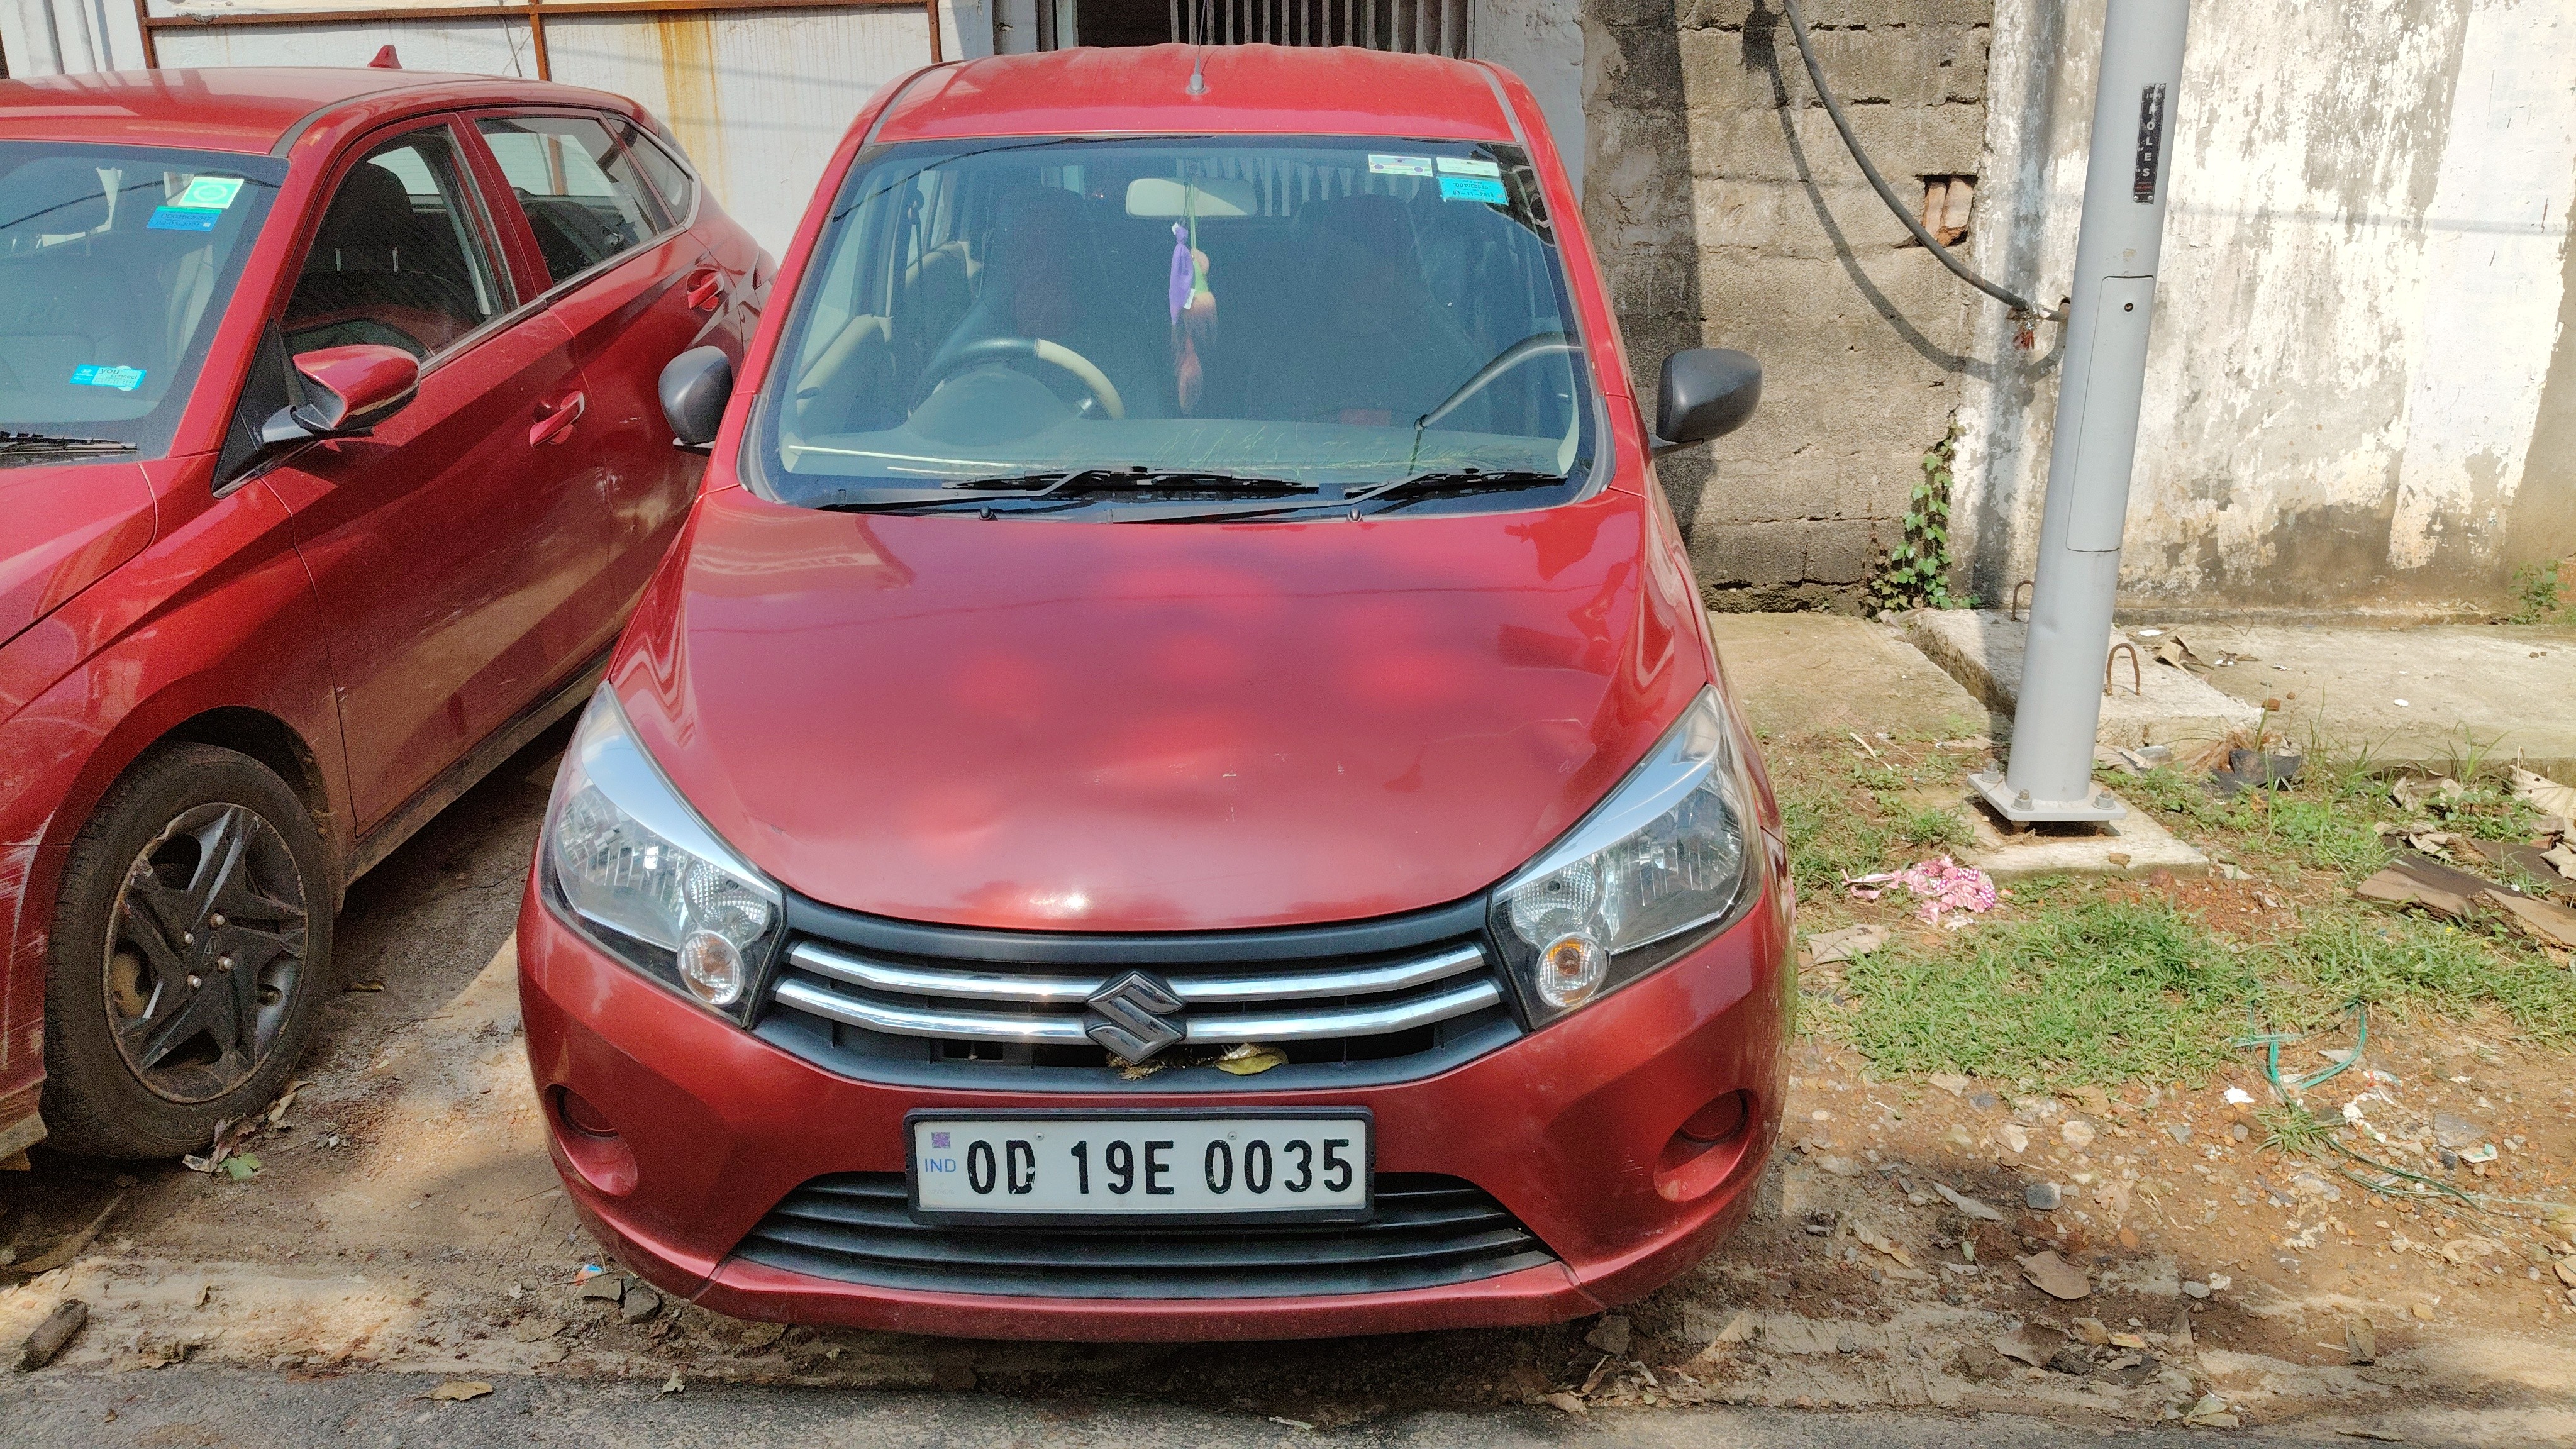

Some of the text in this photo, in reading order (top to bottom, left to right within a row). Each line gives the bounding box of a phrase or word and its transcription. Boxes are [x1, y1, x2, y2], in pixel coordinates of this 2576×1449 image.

[924, 1158, 957, 1173] IND
[967, 1139, 1353, 1196] OD 19E 0035
